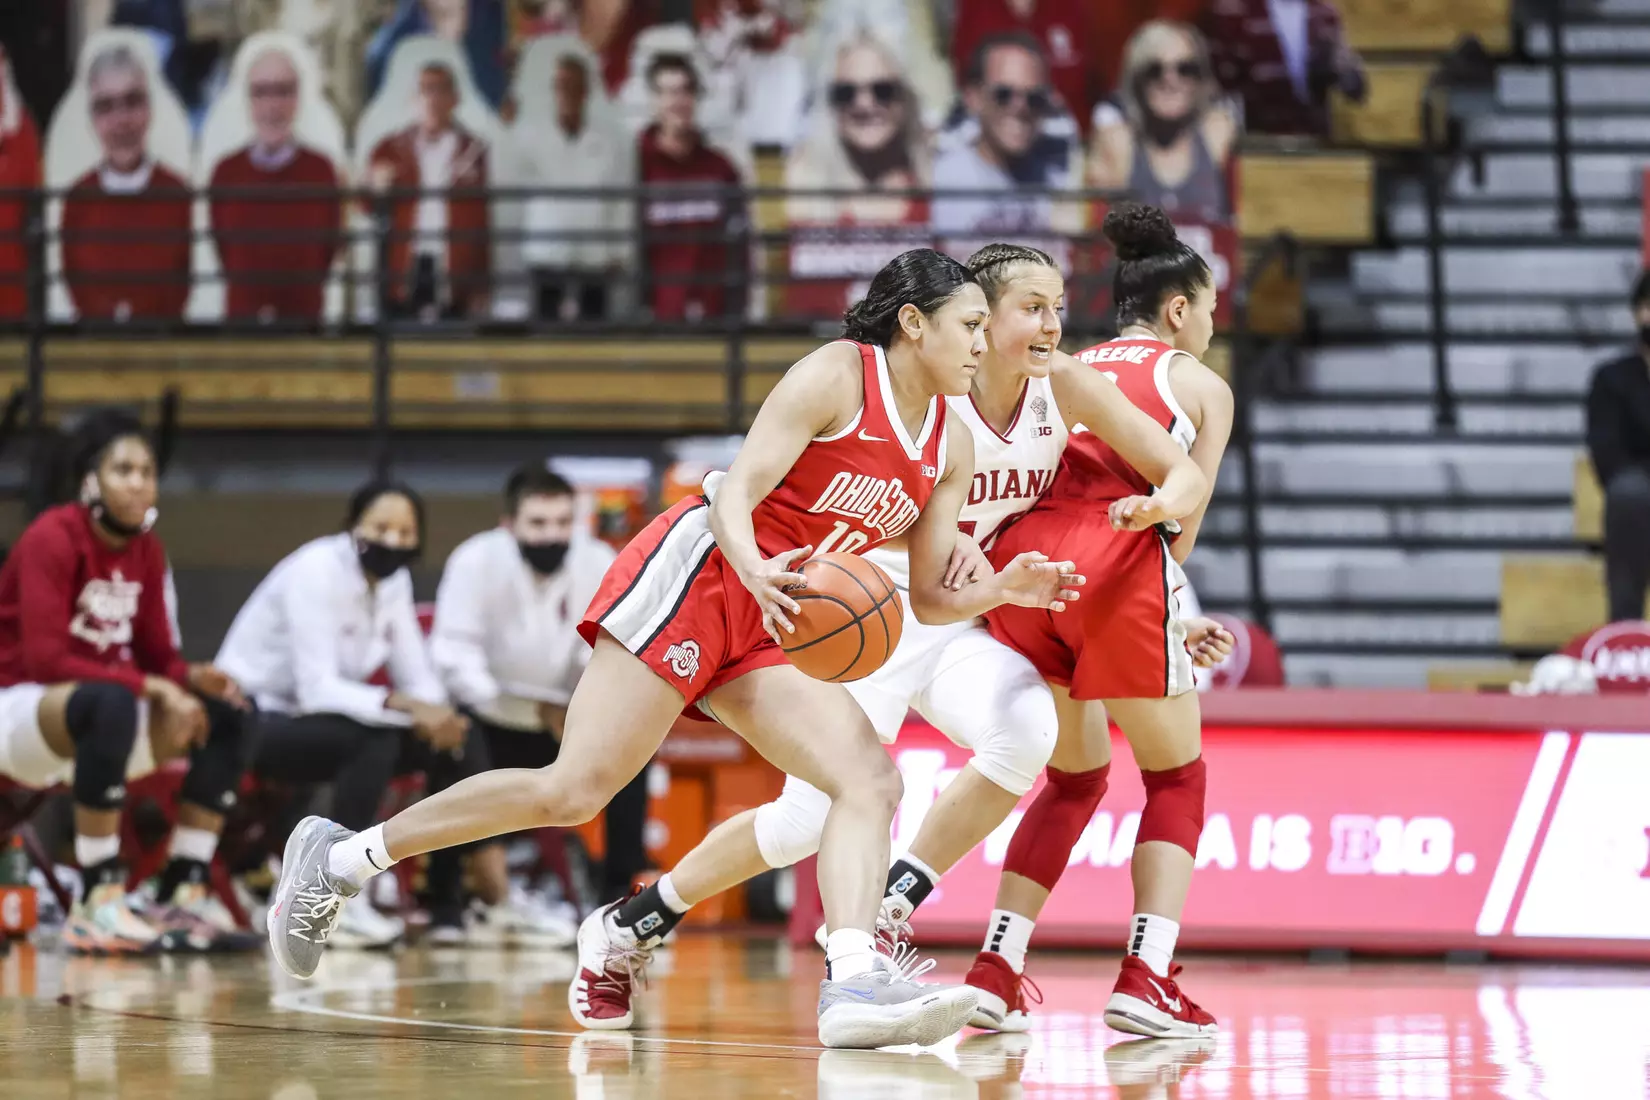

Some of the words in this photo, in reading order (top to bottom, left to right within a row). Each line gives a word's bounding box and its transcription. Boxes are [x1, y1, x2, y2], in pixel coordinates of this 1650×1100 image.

[1073, 345, 1157, 365] REENE
[967, 468, 1052, 506] DIAN
[1250, 814, 1312, 869] IS
